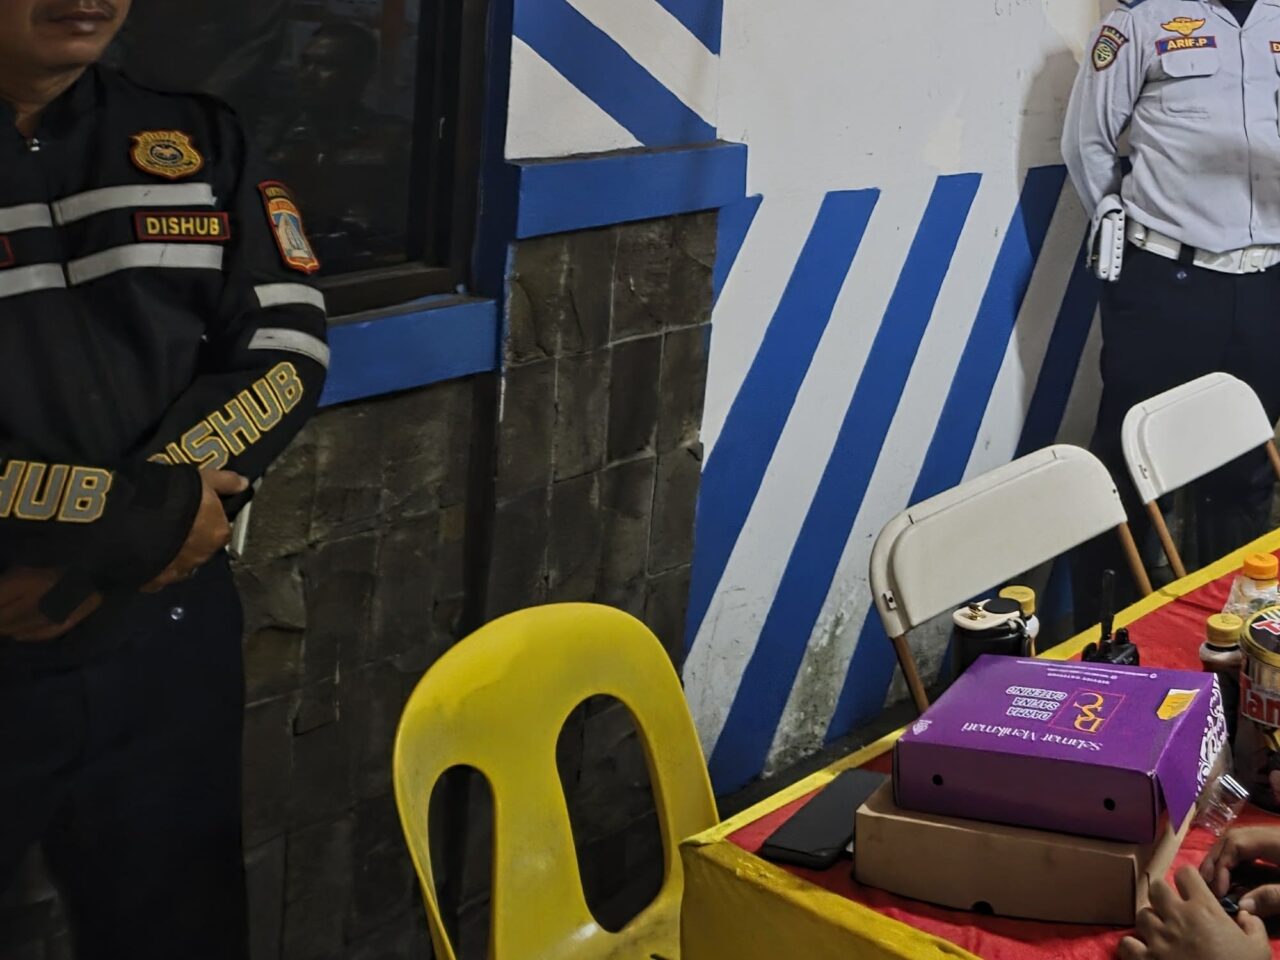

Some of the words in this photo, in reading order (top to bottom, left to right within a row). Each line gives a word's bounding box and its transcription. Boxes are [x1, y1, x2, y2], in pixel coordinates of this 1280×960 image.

[145, 217, 220, 235] DISHUB
[961, 722, 1036, 741] Menikmati
[1041, 733, 1103, 751] Selamat
